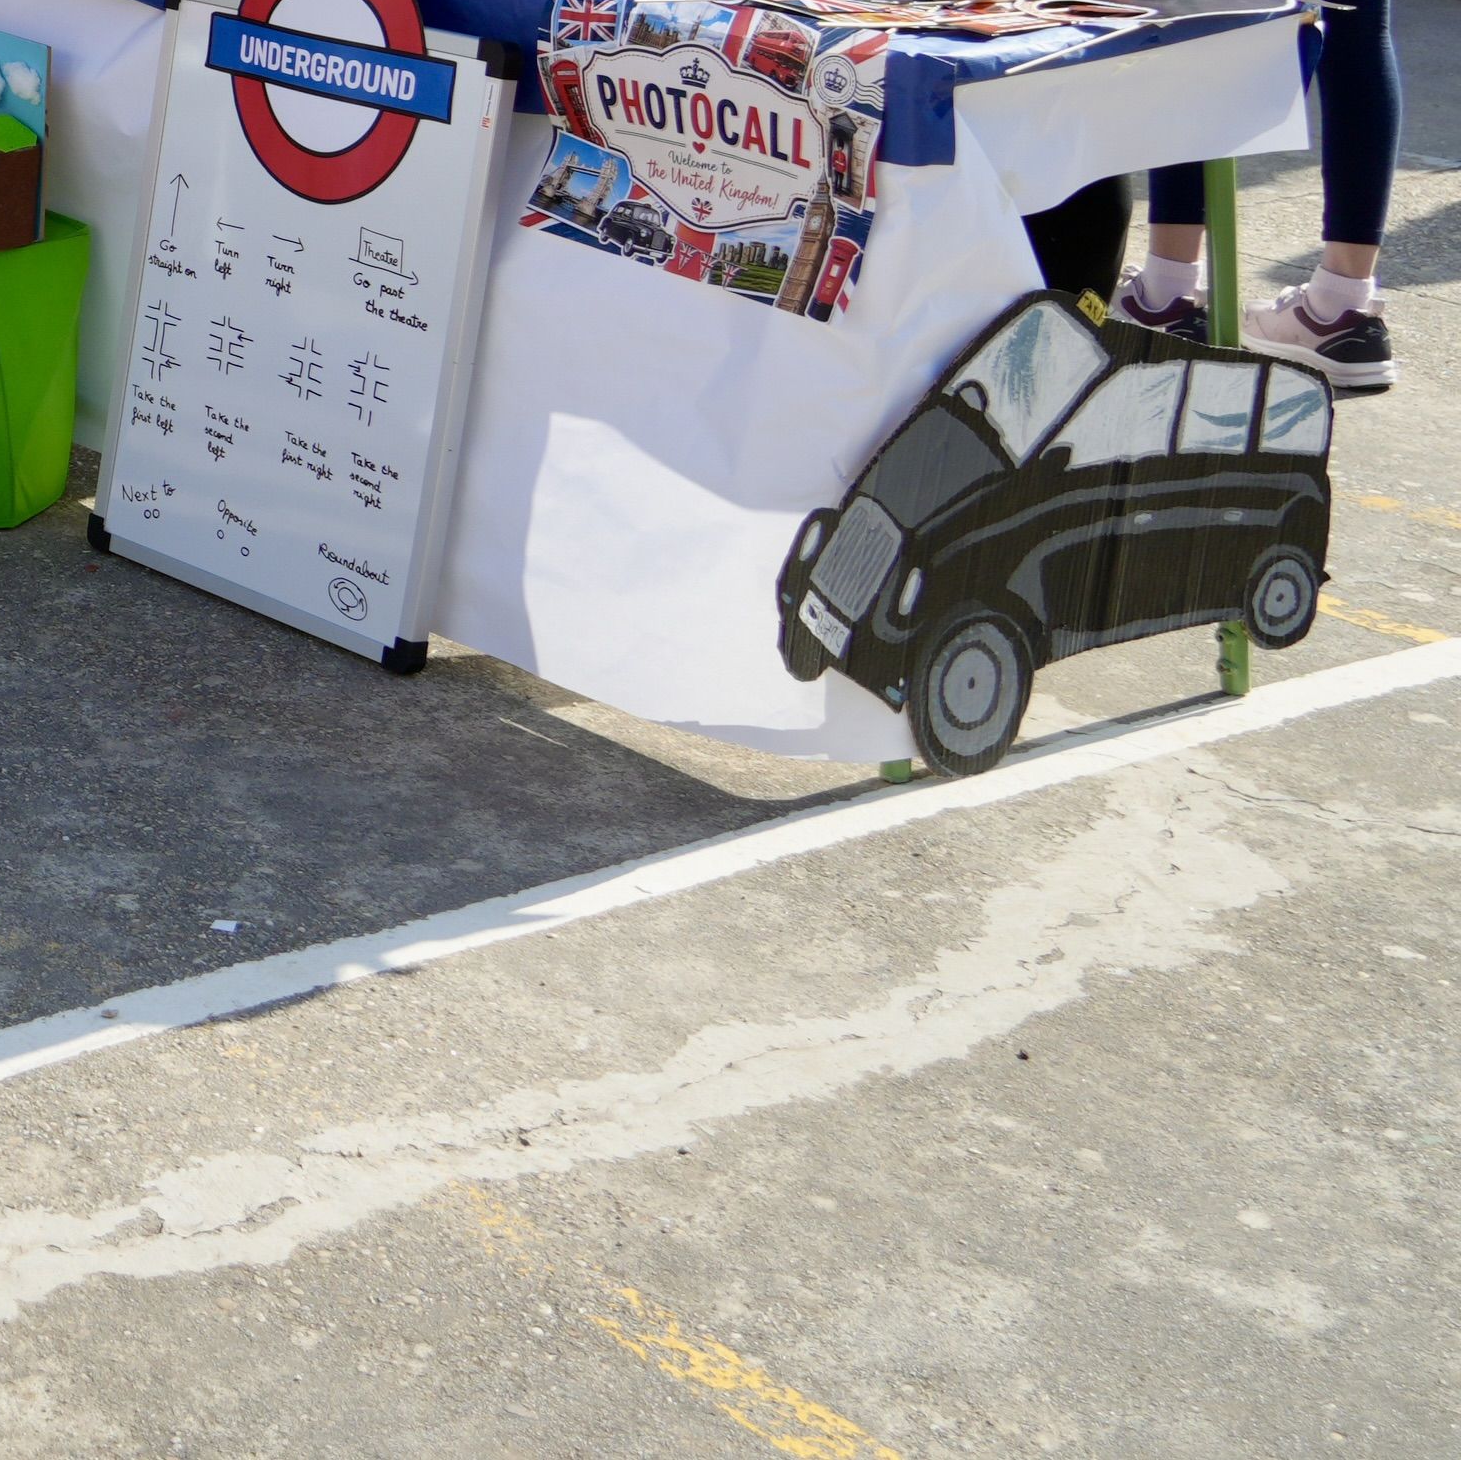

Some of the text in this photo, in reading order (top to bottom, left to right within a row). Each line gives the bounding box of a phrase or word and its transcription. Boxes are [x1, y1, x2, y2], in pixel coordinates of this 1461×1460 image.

[239, 34, 417, 102] UNDERGROUND
[596, 73, 811, 170] PHOTOCALL
[668, 149, 733, 175] Welcome to
[647, 159, 780, 210] the United Kingdom!
[160, 239, 177, 253] Go
[215, 240, 239, 260] Turn
[362, 240, 399, 267] Theatre
[147, 254, 197, 279] straight on
[214, 259, 232, 278] left
[267, 255, 295, 275] Turn
[265, 277, 292, 296] right
[353, 272, 406, 300] Go past
[365, 298, 429, 332] the theatre
[132, 384, 176, 412] Take the
[131, 407, 174, 435] first left
[205, 405, 250, 433] Take the
[204, 426, 233, 445] second
[285, 430, 327, 459] Take the
[207, 441, 225, 462] left
[281, 449, 333, 483] first right
[351, 451, 399, 480] Take the
[122, 483, 176, 504] Next to
[349, 471, 381, 494] second
[353, 488, 382, 511] right
[217, 499, 258, 537] Opposite
[317, 542, 391, 587] Roundabout
